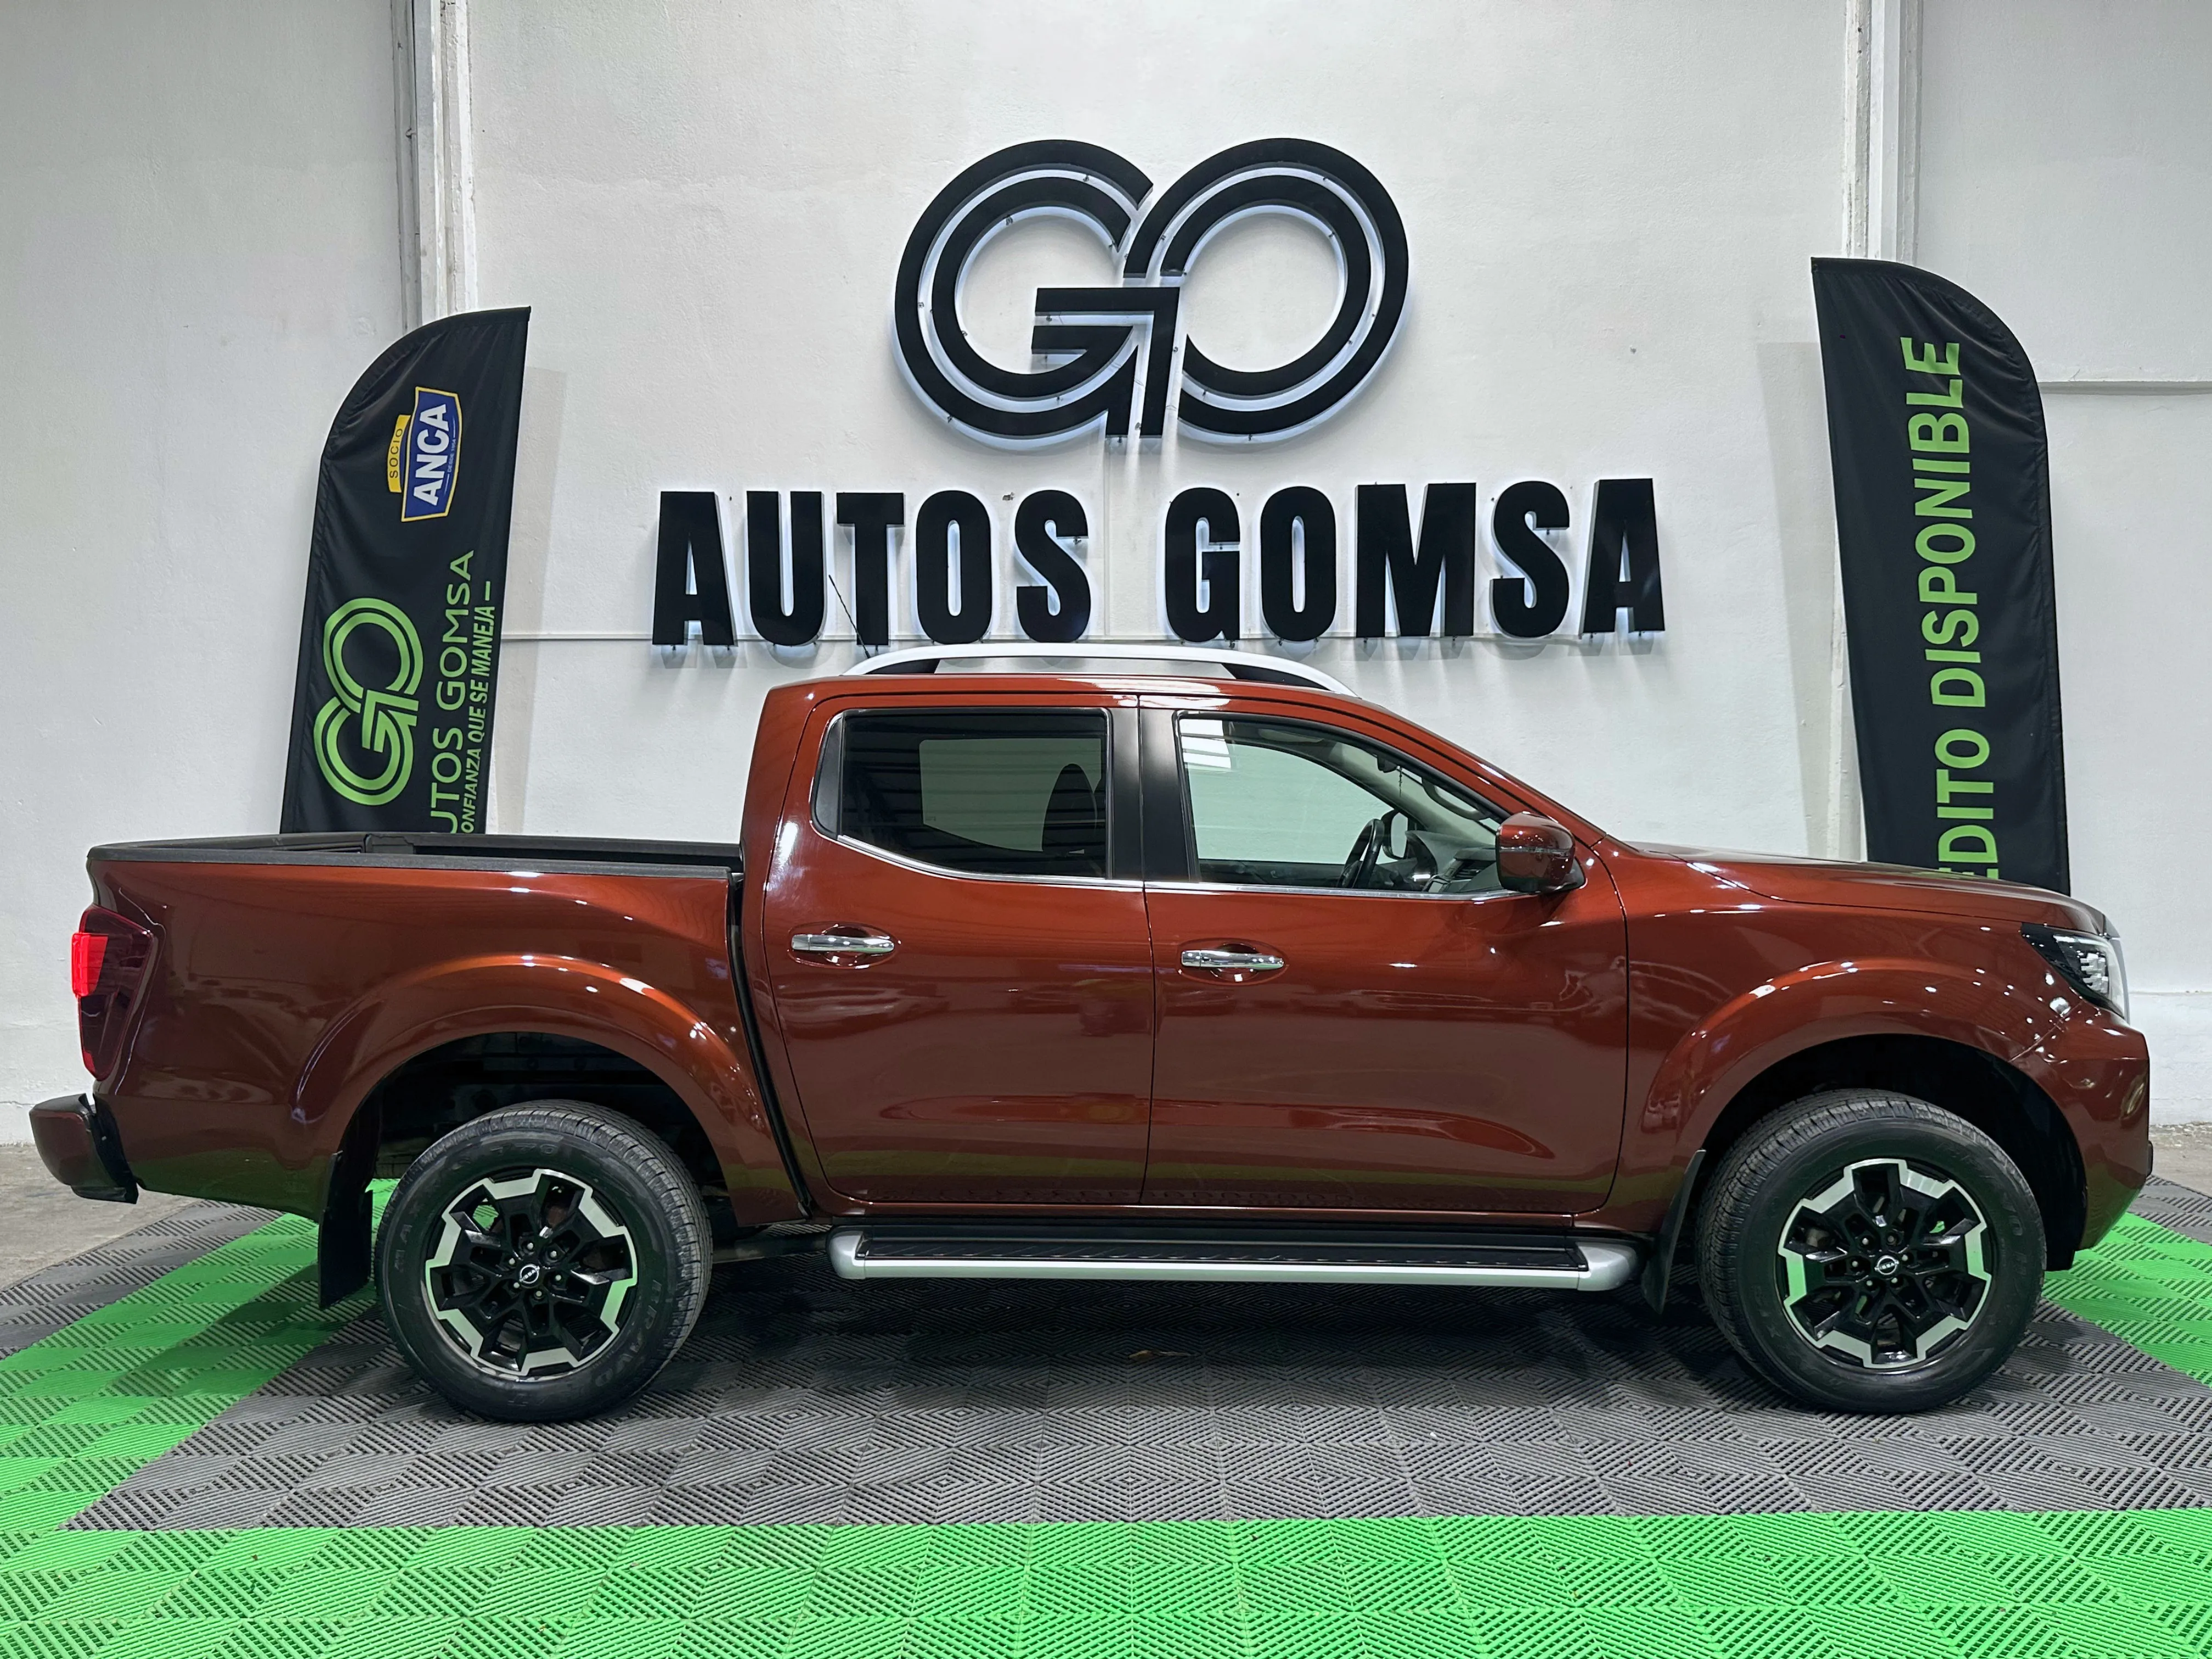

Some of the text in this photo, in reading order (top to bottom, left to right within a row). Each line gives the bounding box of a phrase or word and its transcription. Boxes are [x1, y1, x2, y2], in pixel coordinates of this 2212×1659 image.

[895, 138, 1409, 440] GO
[389, 428, 403, 478] SOCIO
[414, 404, 449, 506] ANCA
[652, 478, 1665, 646] AUTOS GOMSA
[313, 597, 424, 806] GO
[430, 550, 474, 834] UTOS GOMSA
[1900, 337, 2000, 881] DITO DISPONIBLE
[460, 606, 495, 834] ONFIANZA QUE SE MANEJA
